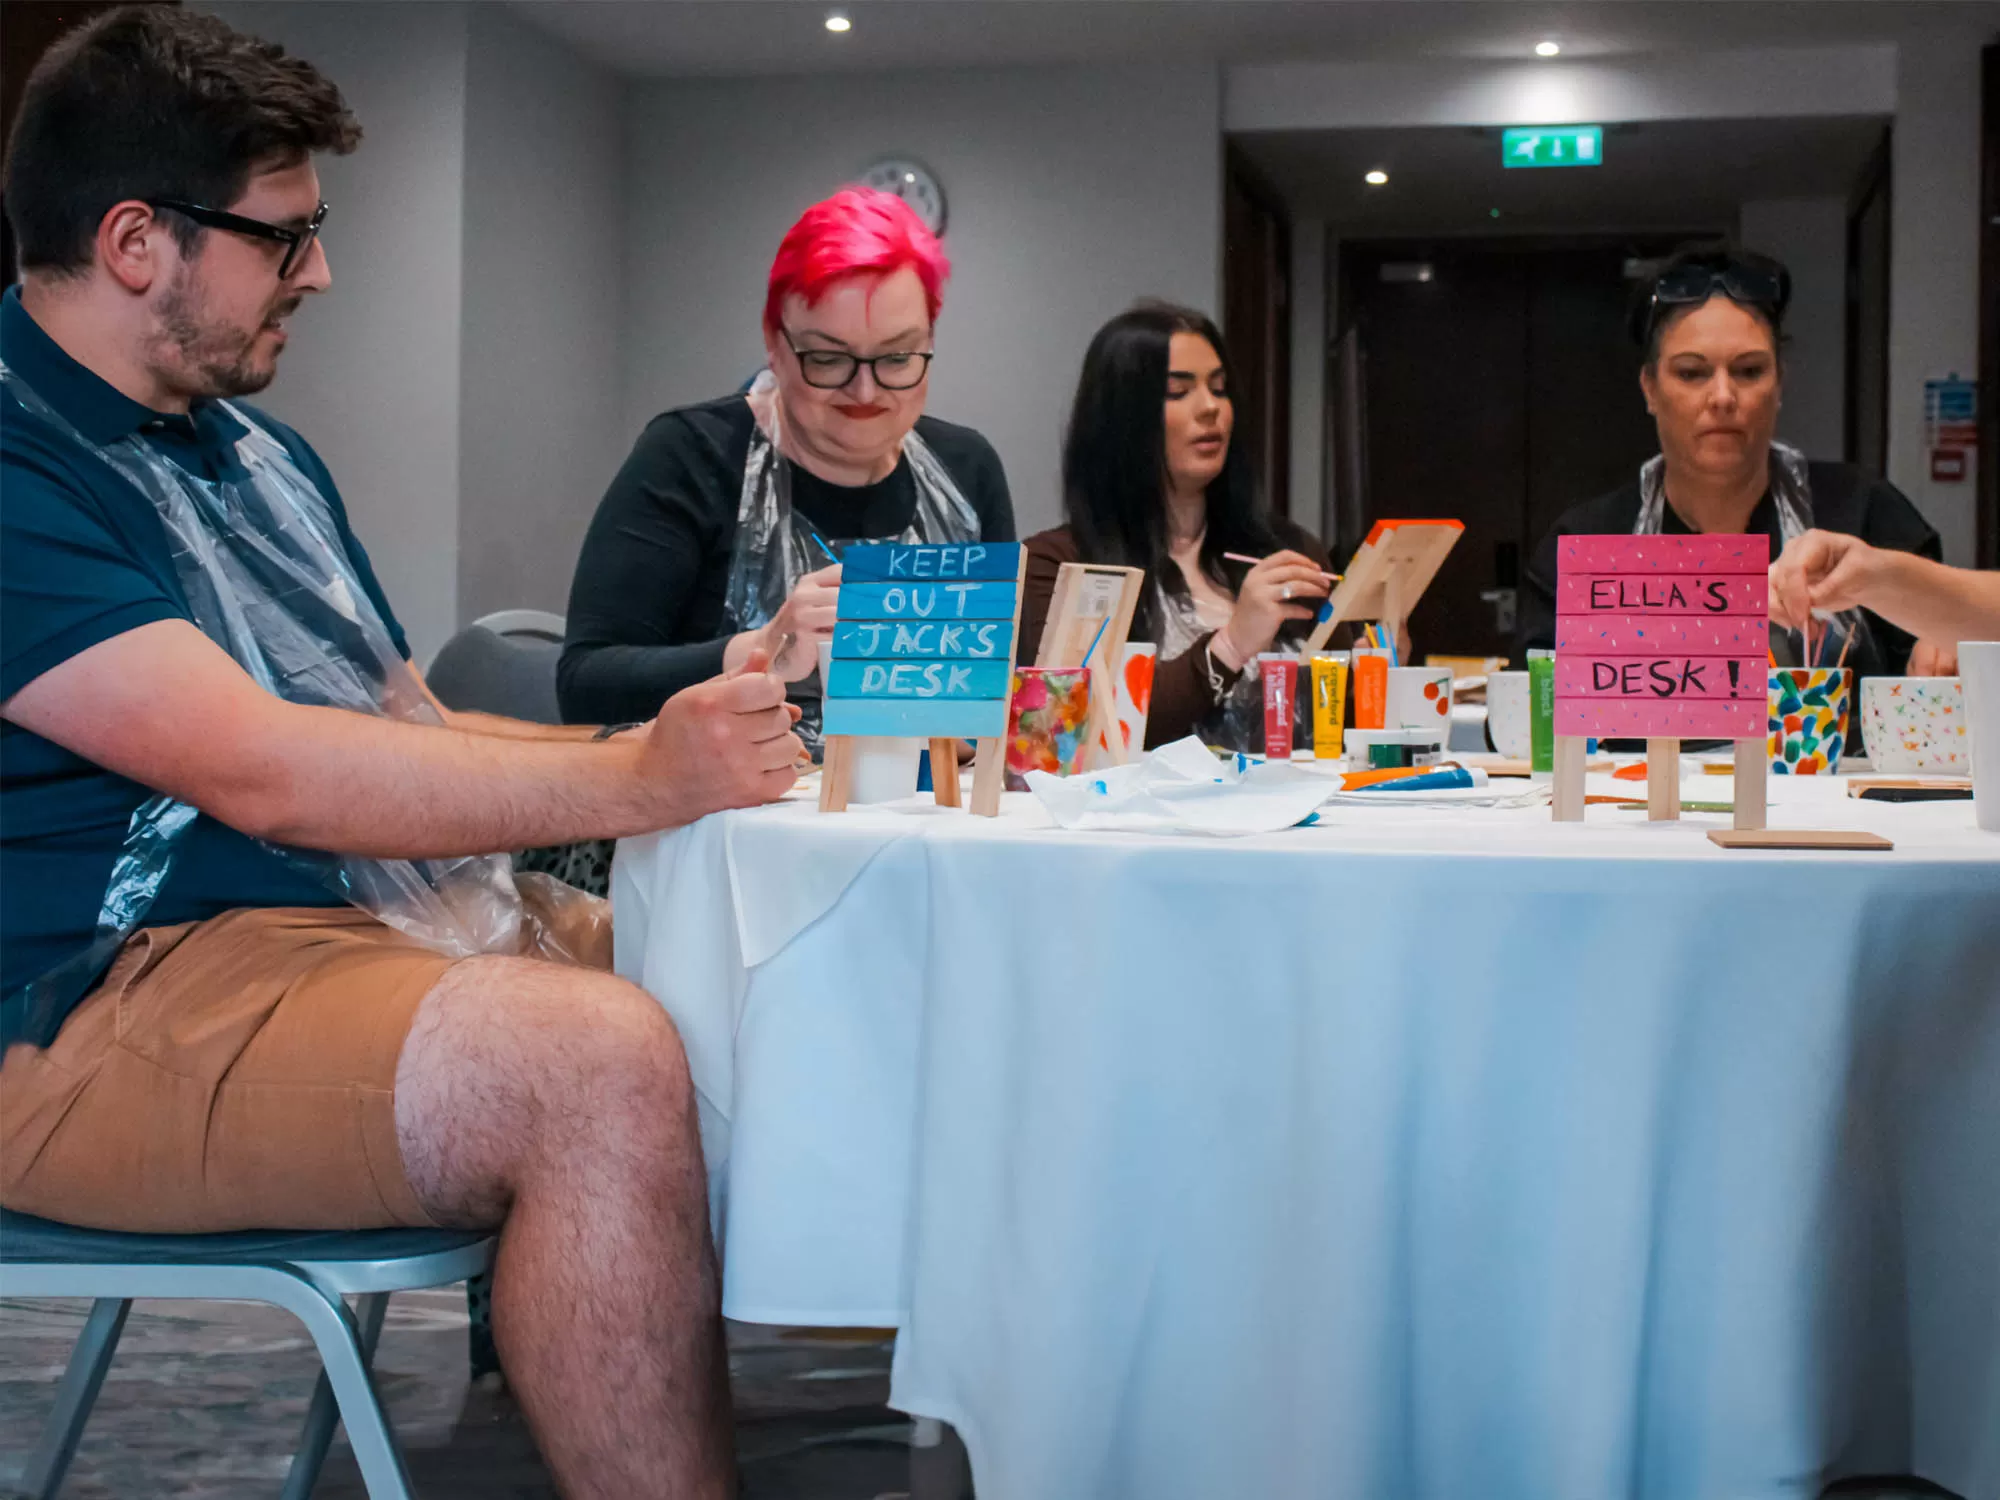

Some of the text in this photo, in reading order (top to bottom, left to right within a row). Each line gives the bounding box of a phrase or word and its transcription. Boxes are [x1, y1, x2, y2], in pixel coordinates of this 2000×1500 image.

[888, 546, 987, 577] KEEP
[882, 583, 983, 617] OUT
[1590, 579, 1729, 613] ELLA'S
[856, 623, 998, 658] JACK'S
[860, 664, 973, 698] DESK
[1592, 659, 1707, 698] DESK
